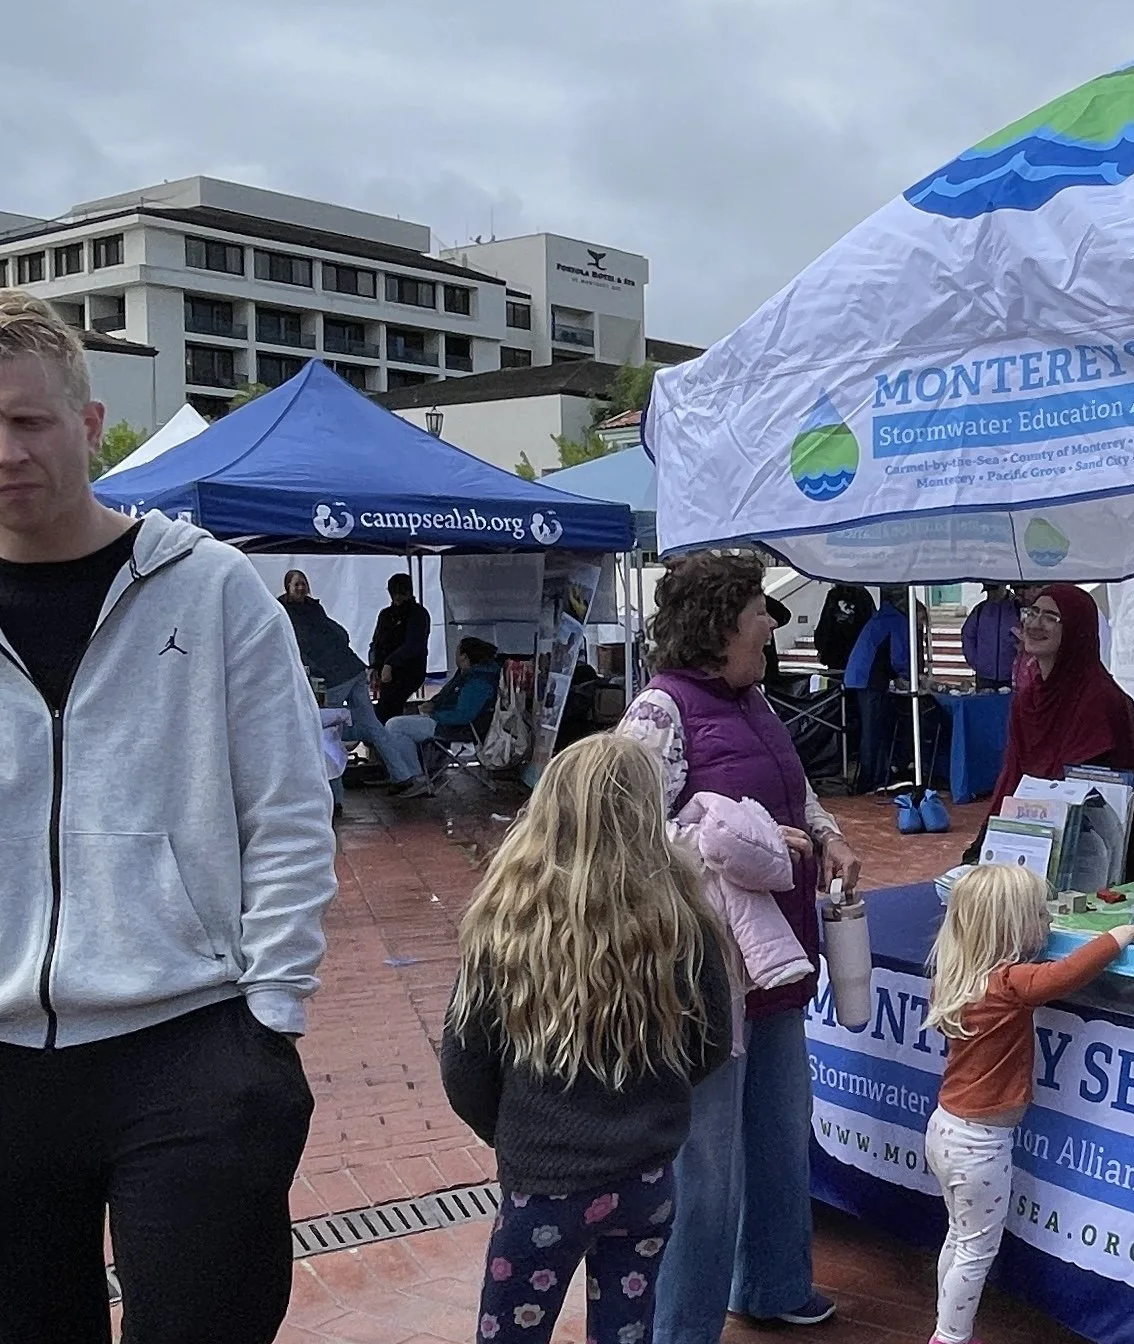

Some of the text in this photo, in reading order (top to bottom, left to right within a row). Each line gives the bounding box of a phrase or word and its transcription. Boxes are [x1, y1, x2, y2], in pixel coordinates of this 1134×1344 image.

[872, 344, 1127, 408] MONTEREY
[879, 419, 1012, 446] Stormwater
[1018, 399, 1123, 432] Education
[885, 455, 1000, 475] Carmel-by-the-Sea
[1010, 451, 1055, 463] County
[1056, 445, 1070, 457] of
[1071, 438, 1127, 456] Monterey
[916, 474, 976, 489] Monterey
[987, 467, 1028, 482] Pacific
[1030, 465, 1067, 478] Grove
[1075, 458, 1103, 472] Sand
[1106, 455, 1130, 468] City
[360, 507, 525, 540] campsealab.org
[809, 1055, 930, 1116] Stormwater
